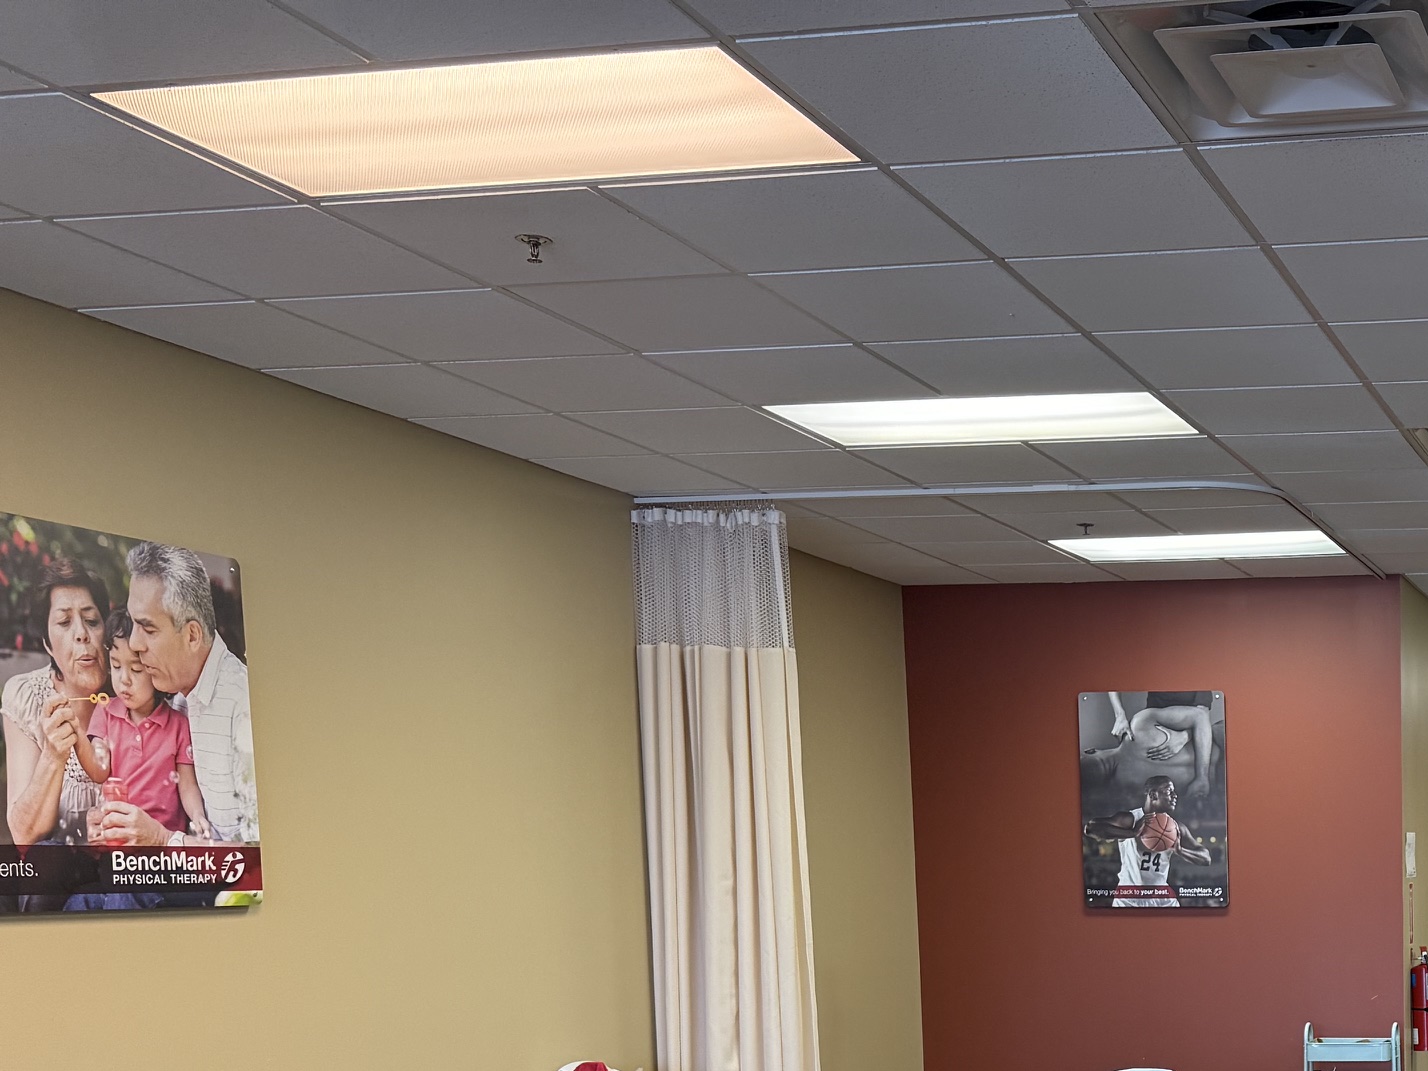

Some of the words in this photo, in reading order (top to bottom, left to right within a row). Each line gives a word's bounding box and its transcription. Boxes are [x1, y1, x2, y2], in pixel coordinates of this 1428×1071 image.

[0, 859, 39, 877] ents.
[112, 850, 217, 871] BenchMark
[1140, 851, 1161, 872] 24
[113, 874, 167, 885] PHYSICAL
[170, 873, 217, 884] THERAPY
